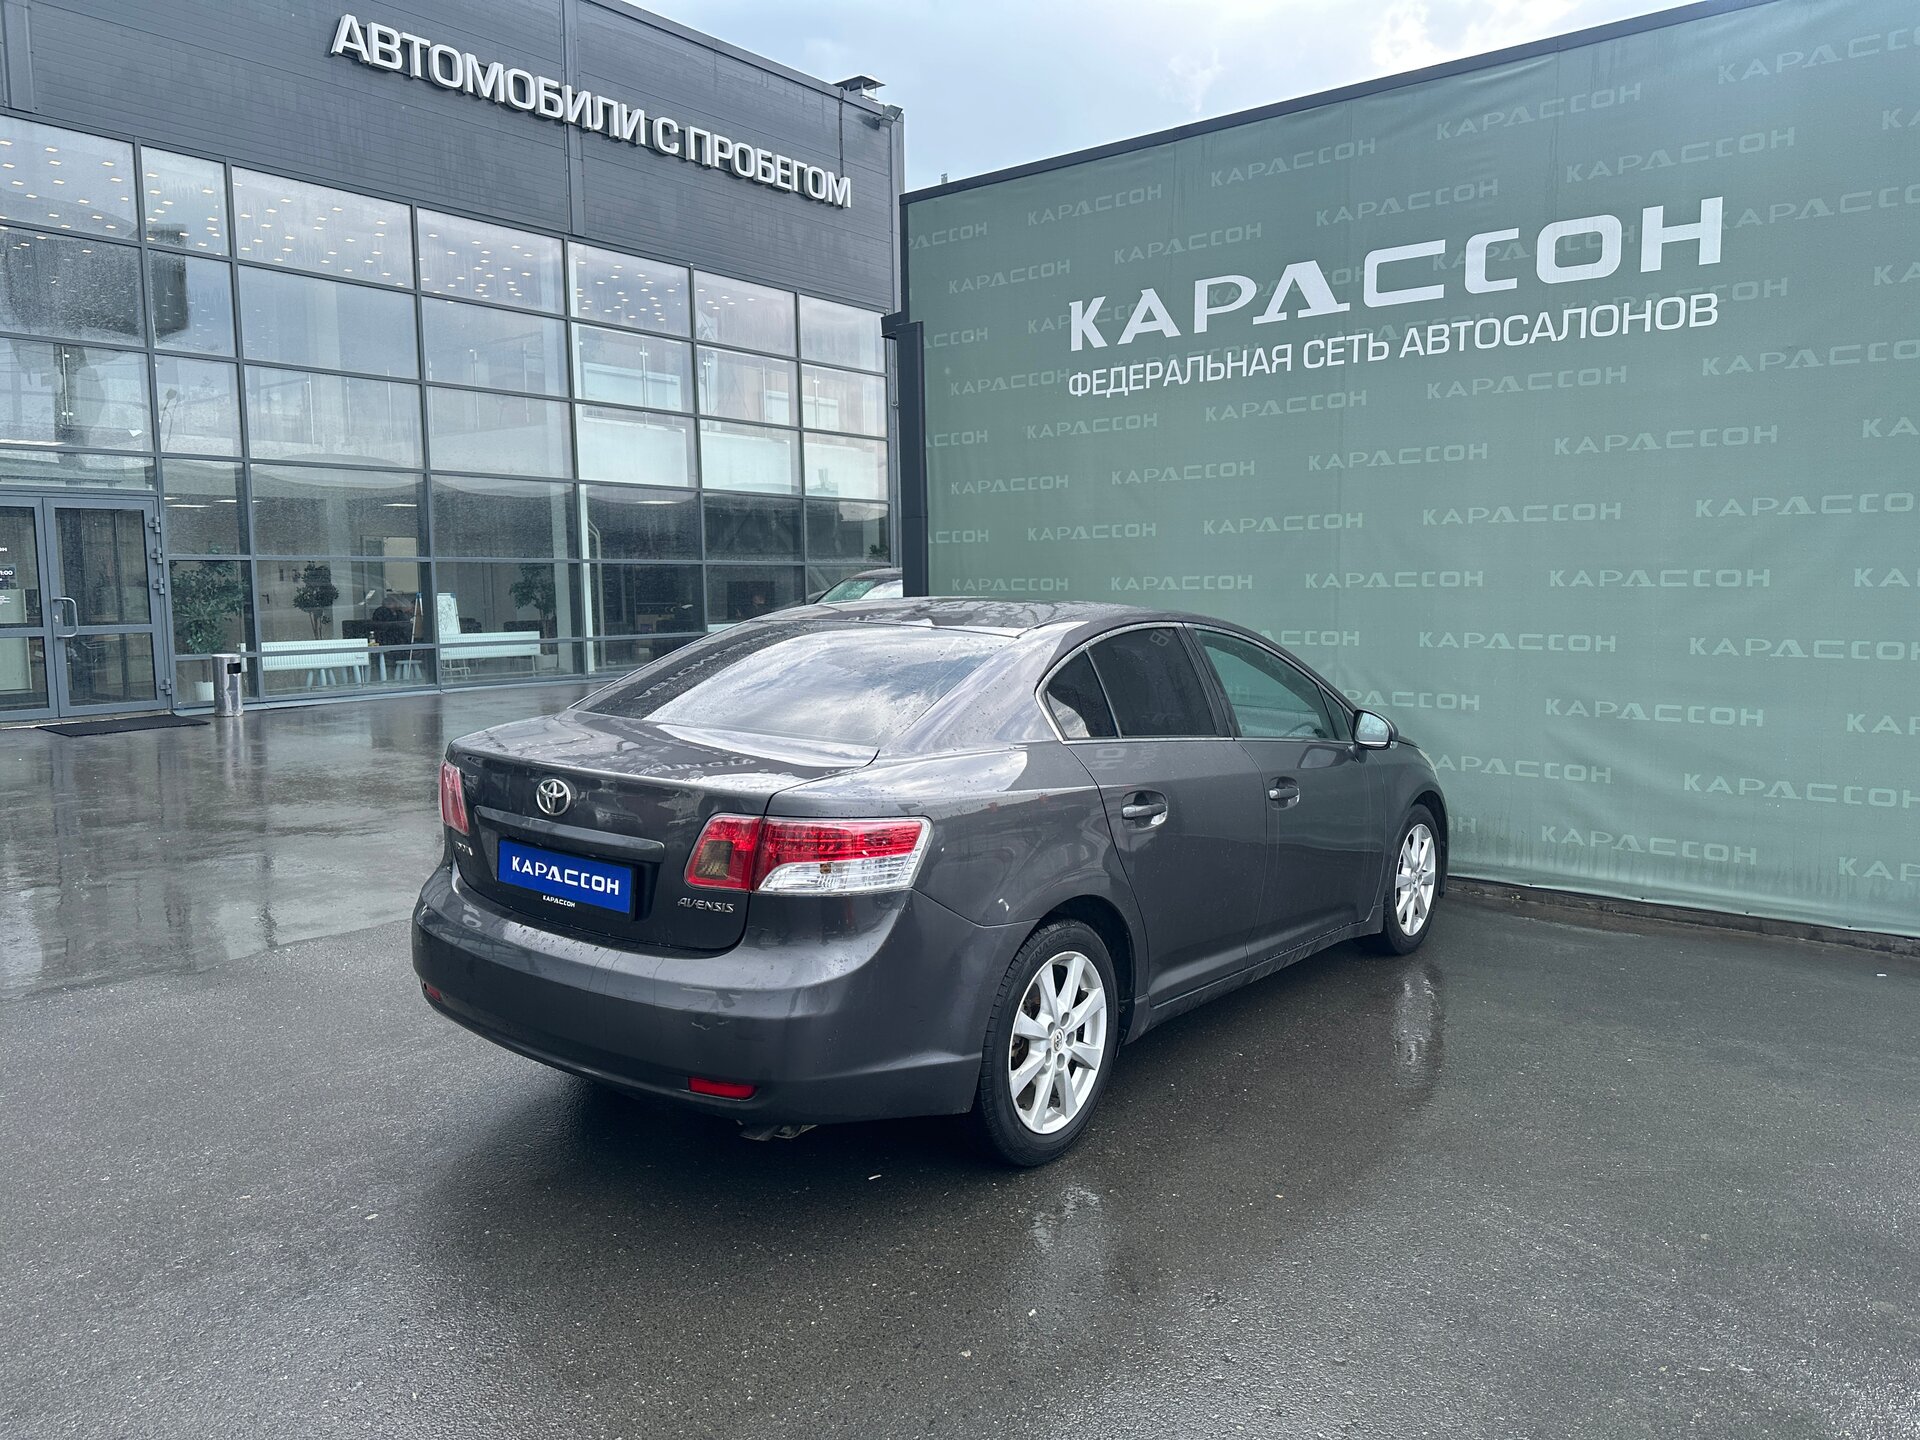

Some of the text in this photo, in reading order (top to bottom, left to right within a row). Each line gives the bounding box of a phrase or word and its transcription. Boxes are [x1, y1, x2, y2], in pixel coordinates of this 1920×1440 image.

[331, 14, 852, 208] АВТОМОБИЛИ С ПРОБЕГОМ
[1068, 292, 1719, 399] ФЕДЕРАЛЬНАЯ СЕТЬ АВТОСАЛОНОВ
[677, 897, 734, 914] AVENSIS
